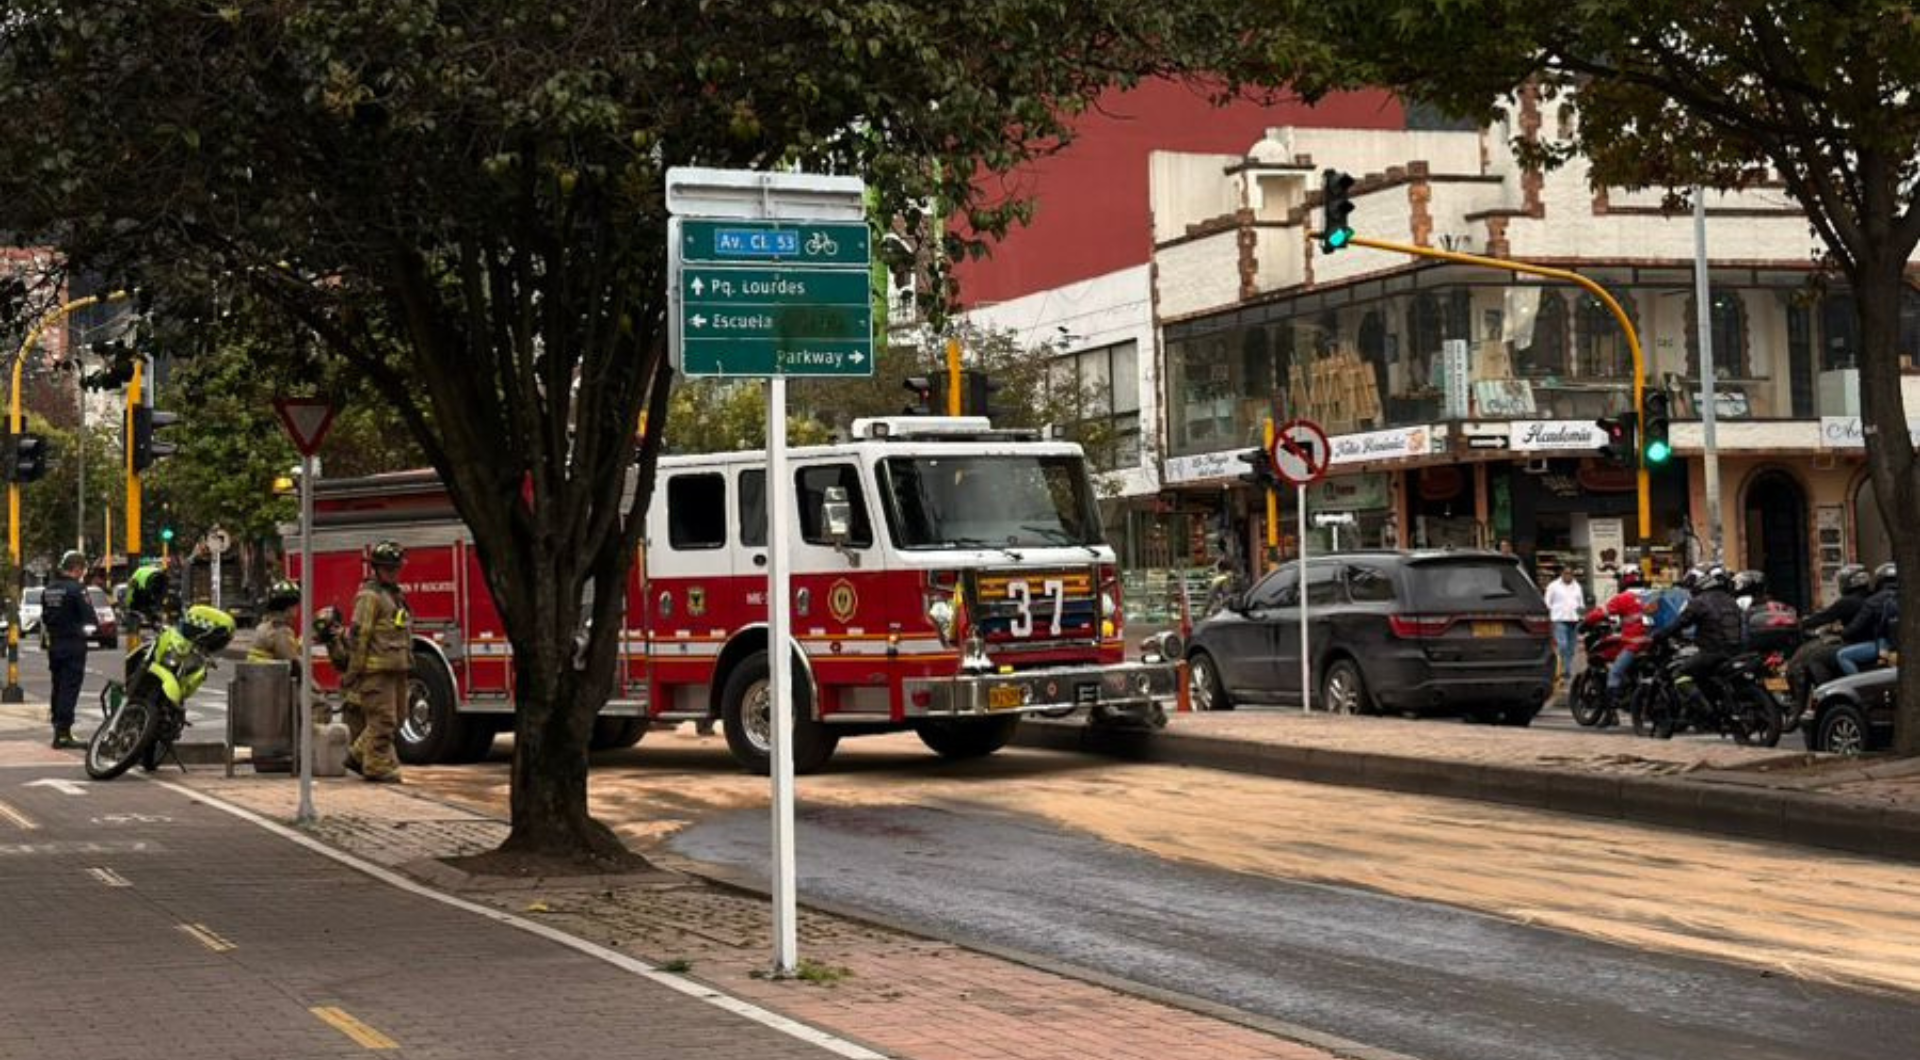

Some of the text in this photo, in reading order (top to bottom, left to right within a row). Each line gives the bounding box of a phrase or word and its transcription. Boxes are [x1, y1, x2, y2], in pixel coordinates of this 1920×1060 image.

[720, 234, 743, 249] Av.
[776, 235, 795, 250] 53
[711, 279, 806, 297] Pq. Lourdes
[712, 314, 773, 329] Escuela
[776, 349, 843, 368] Parkway
[1007, 578, 1064, 638] 37
